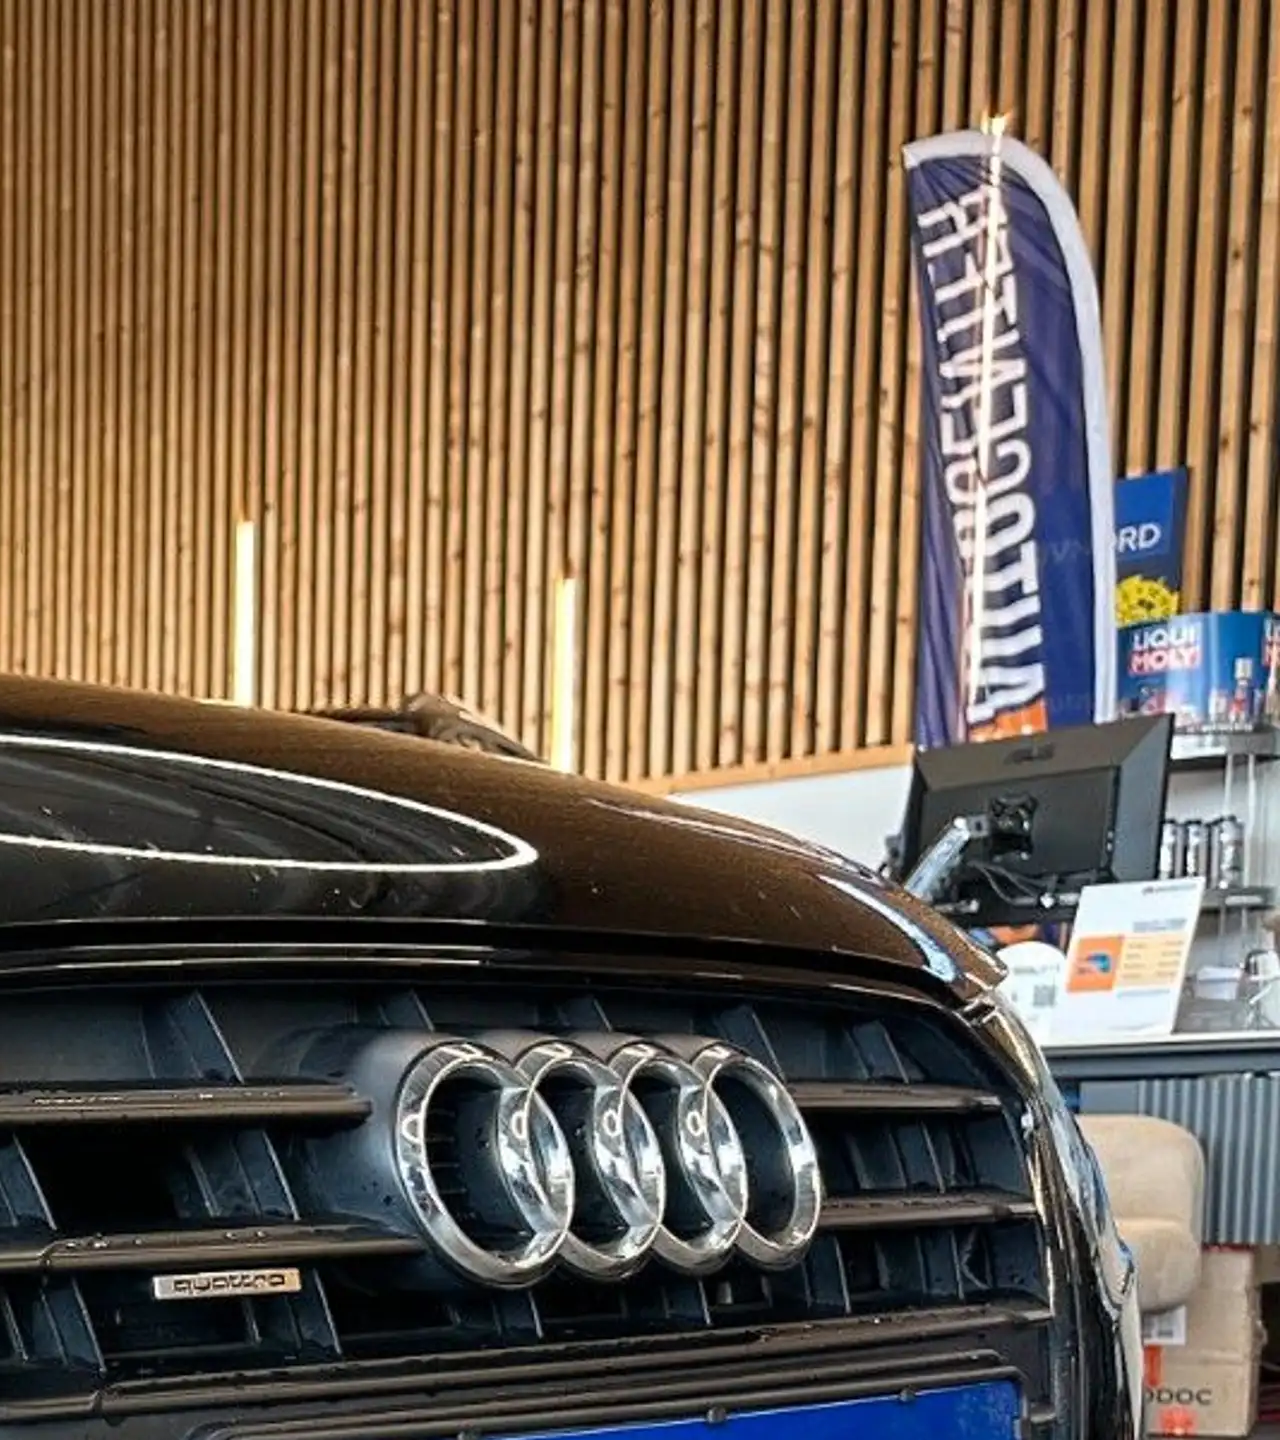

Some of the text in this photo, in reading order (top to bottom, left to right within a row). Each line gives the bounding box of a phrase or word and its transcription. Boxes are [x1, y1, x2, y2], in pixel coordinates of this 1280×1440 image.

[1117, 523, 1161, 552] RD
[1133, 625, 1197, 650] LIQUI
[1131, 647, 1198, 673] MOLY
[173, 1273, 286, 1295] quattro
